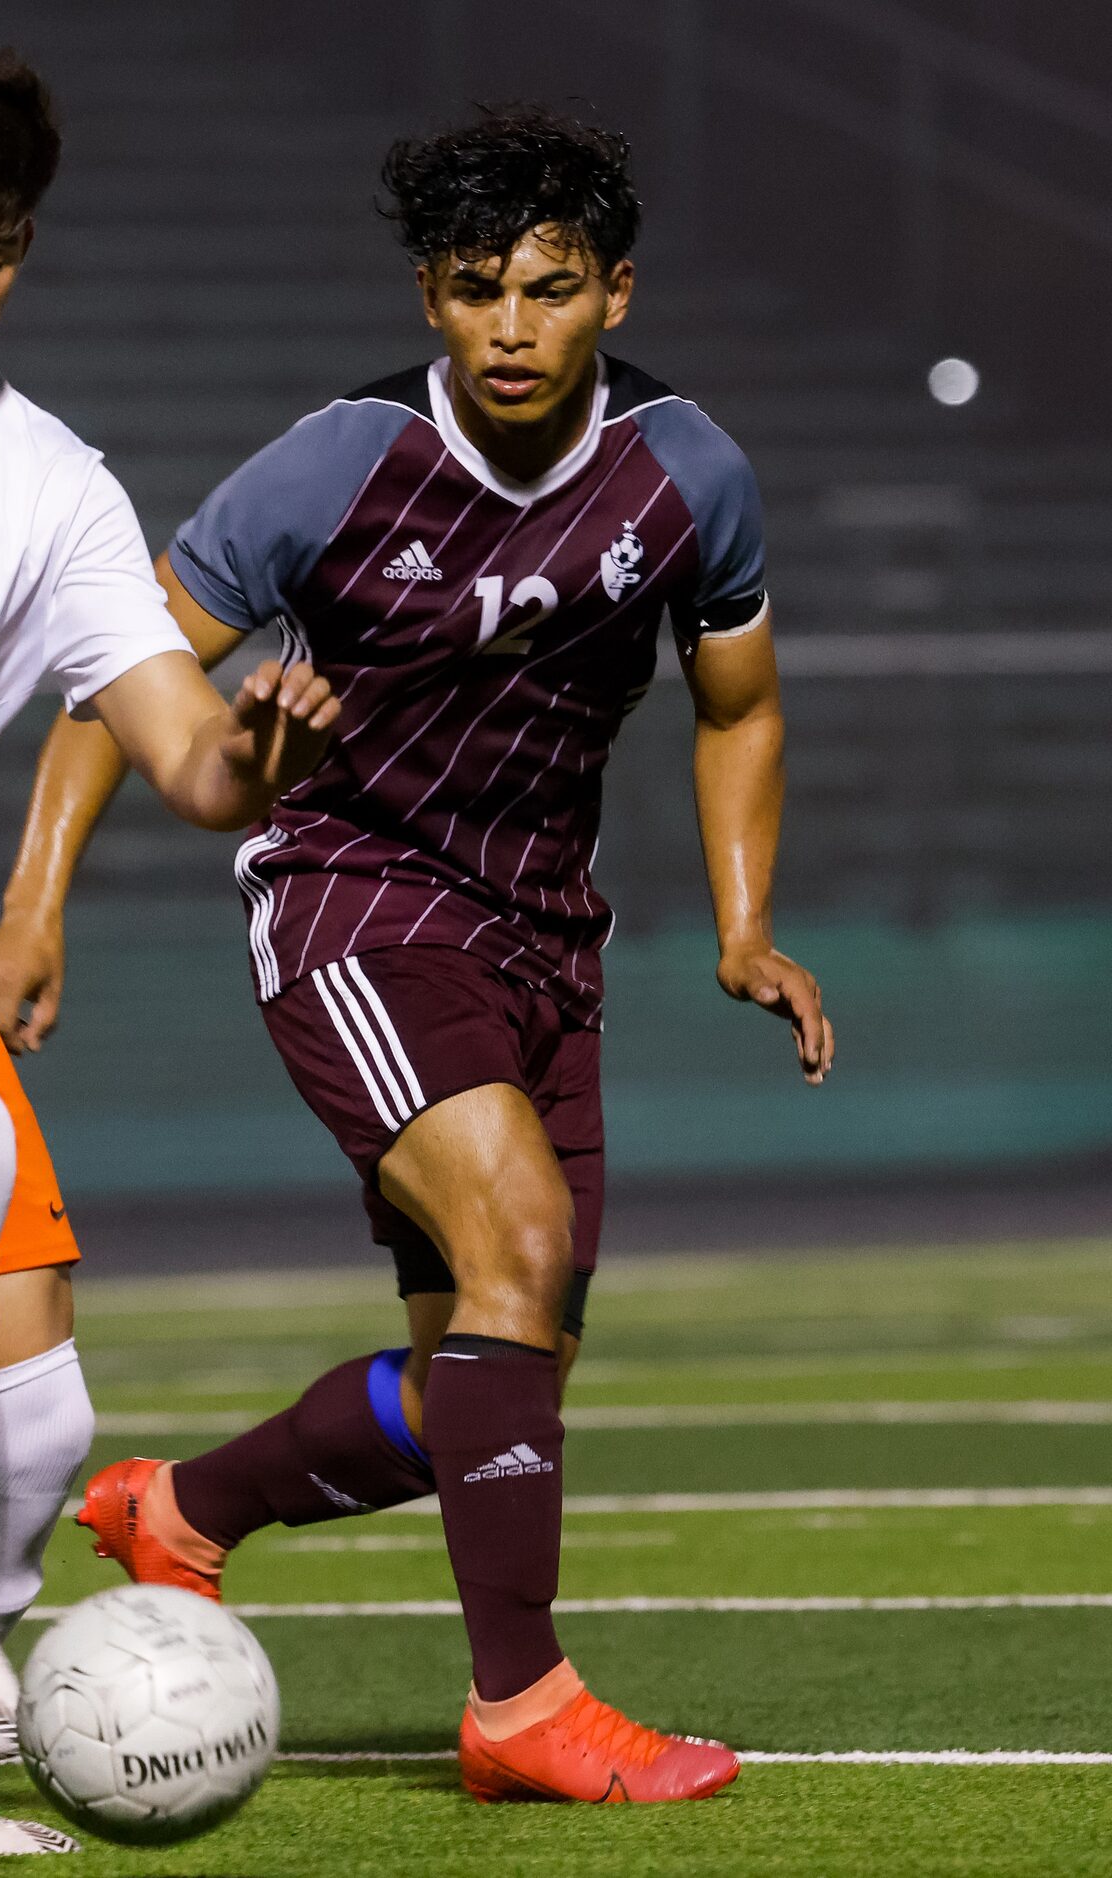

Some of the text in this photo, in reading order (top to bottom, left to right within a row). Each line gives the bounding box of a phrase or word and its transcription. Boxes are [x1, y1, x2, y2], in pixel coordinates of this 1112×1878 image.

[382, 566, 443, 580] adidas
[475, 575, 559, 655] 12
[464, 1461, 554, 1482] adidas
